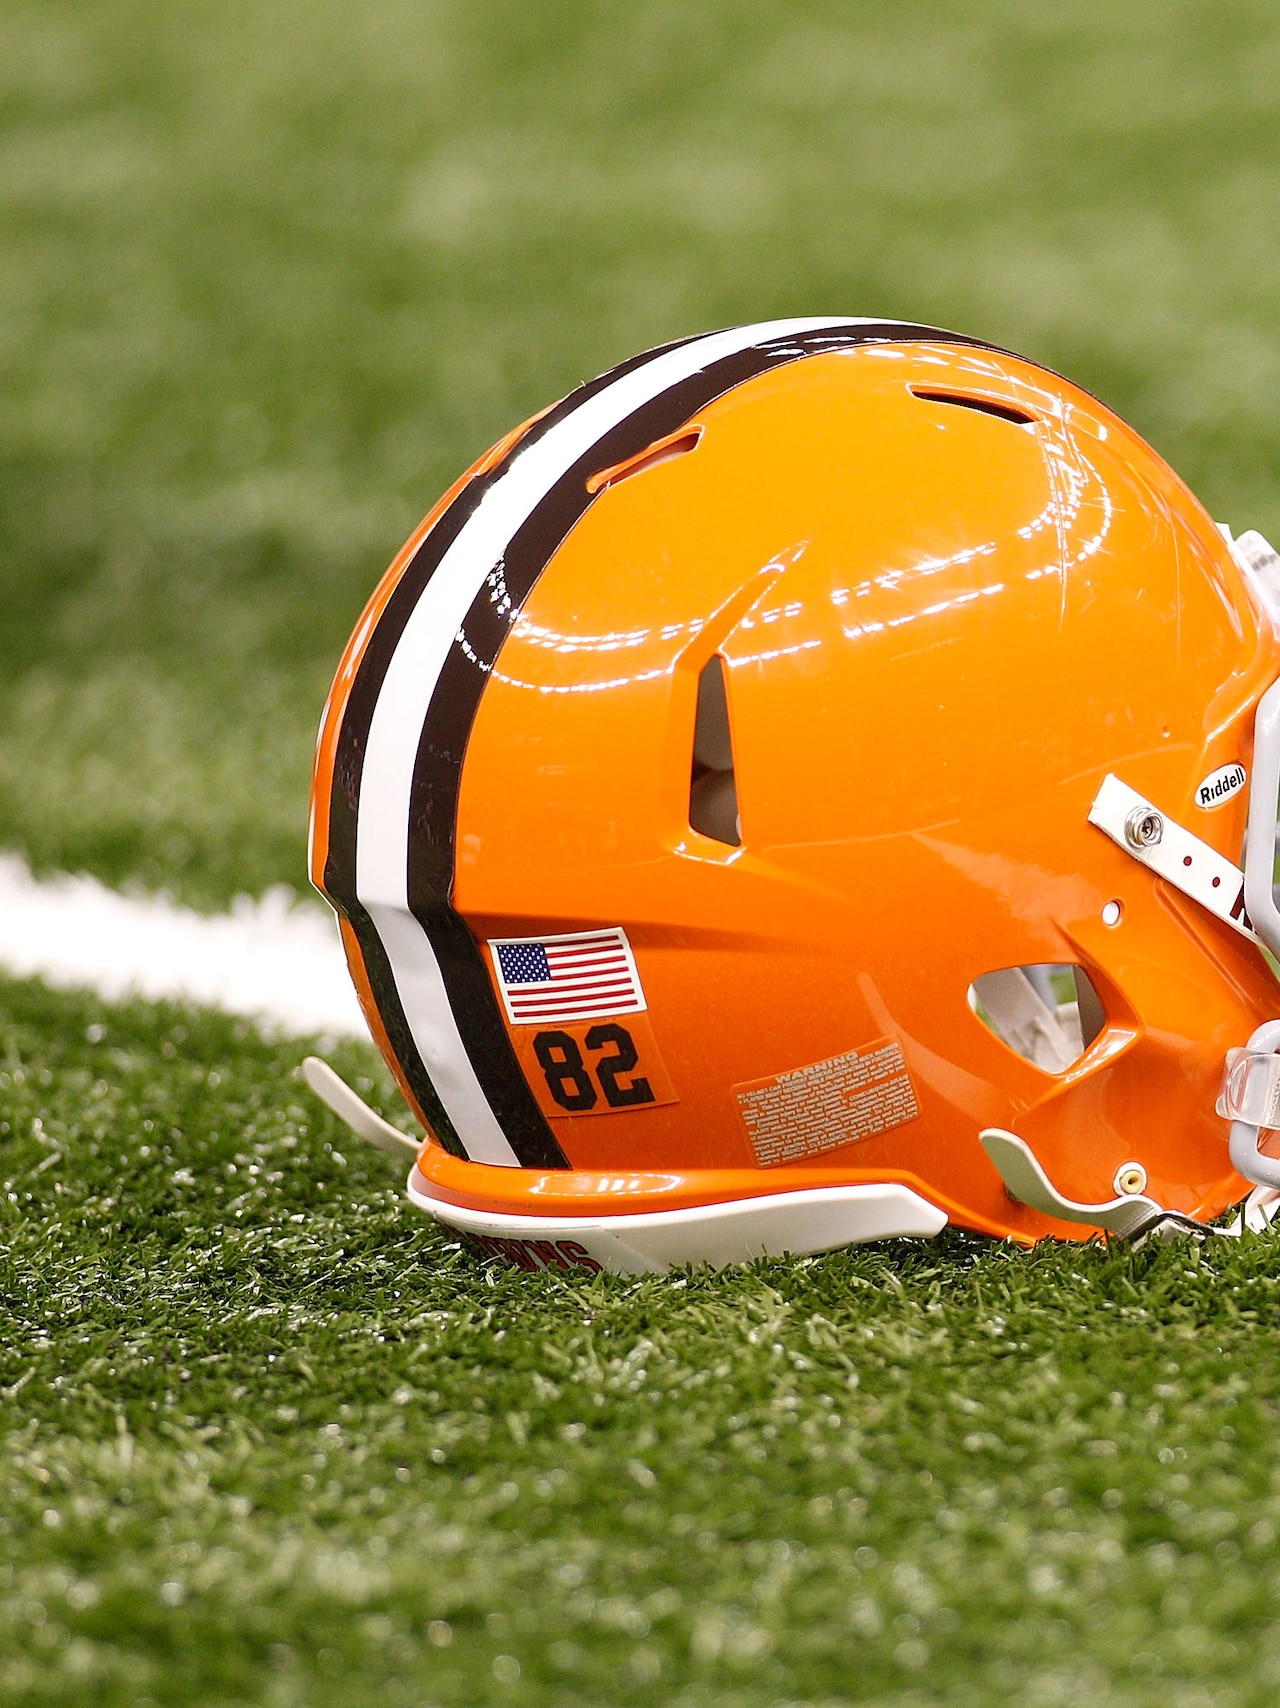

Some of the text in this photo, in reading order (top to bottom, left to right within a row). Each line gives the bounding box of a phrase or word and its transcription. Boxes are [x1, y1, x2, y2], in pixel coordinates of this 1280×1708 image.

[1199, 766, 1246, 805] Riddell
[532, 1023, 656, 1111] 82
[775, 1051, 858, 1084] WARNING
